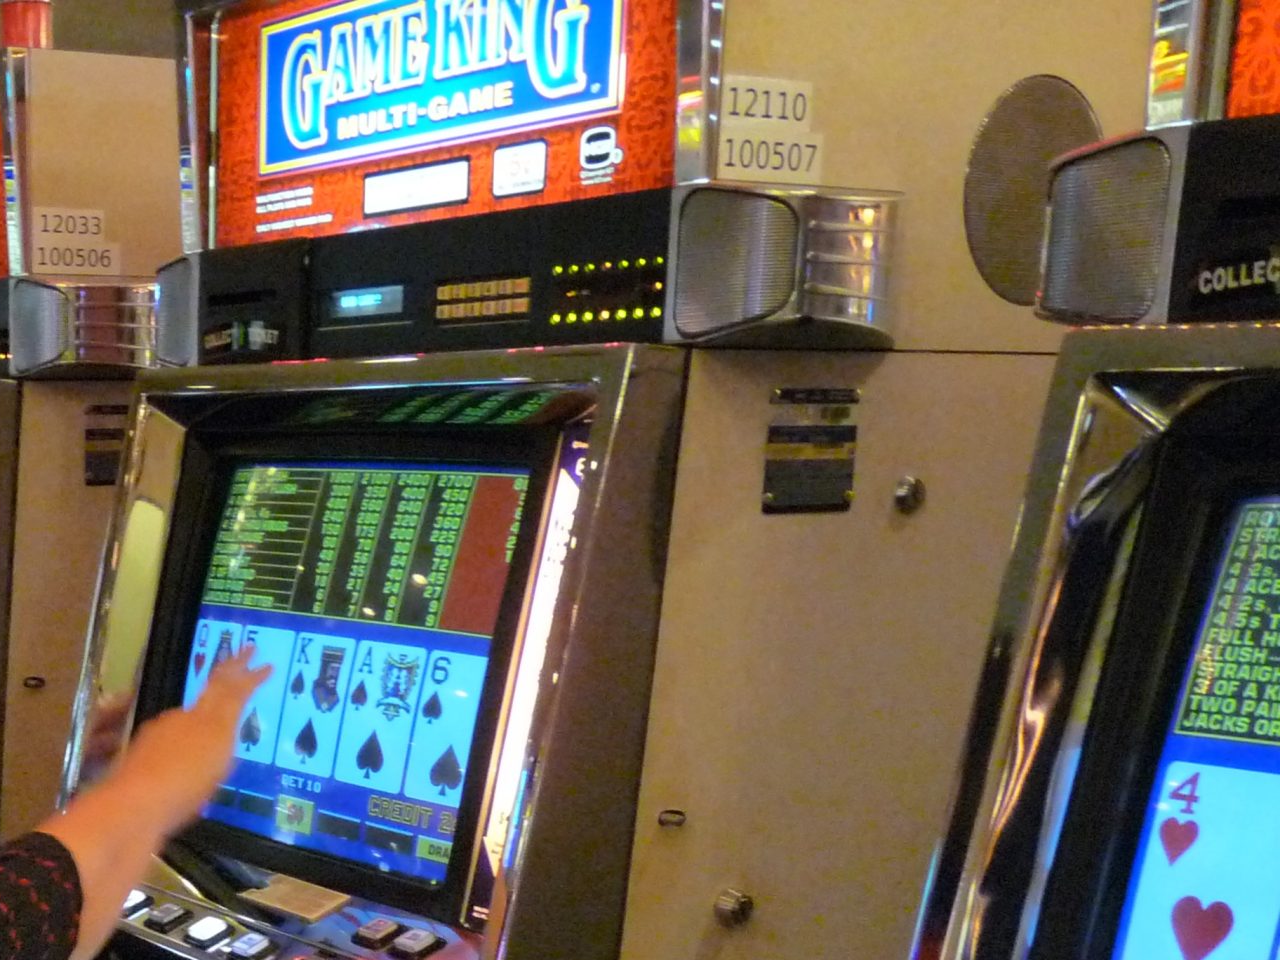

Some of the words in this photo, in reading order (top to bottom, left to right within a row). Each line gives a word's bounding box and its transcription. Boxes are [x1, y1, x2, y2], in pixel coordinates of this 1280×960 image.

[281, 1, 429, 149] GAME
[337, 81, 514, 140] MULTI-GAME
[729, 87, 807, 122] 12110
[724, 138, 817, 172] 100507
[40, 214, 102, 235] 12033
[38, 247, 111, 268] 100506
[438, 476, 473, 488] 2700
[438, 502, 465, 515] 720
[430, 530, 457, 543] 225
[432, 557, 449, 571] 72
[423, 585, 442, 598] 27
[1208, 628, 1254, 645] FULL
[297, 637, 313, 664] K
[358, 646, 373, 674] A
[431, 656, 451, 685] 6
[1203, 644, 1268, 664] FLUSH
[1214, 679, 1241, 696] OF
[1242, 682, 1258, 698] A
[1190, 695, 1236, 714] TWO
[1183, 712, 1250, 734] JACKS
[281, 774, 305, 790] BET
[306, 780, 321, 793] 10
[1168, 772, 1201, 815] 4
[368, 794, 433, 829] CREDIT
